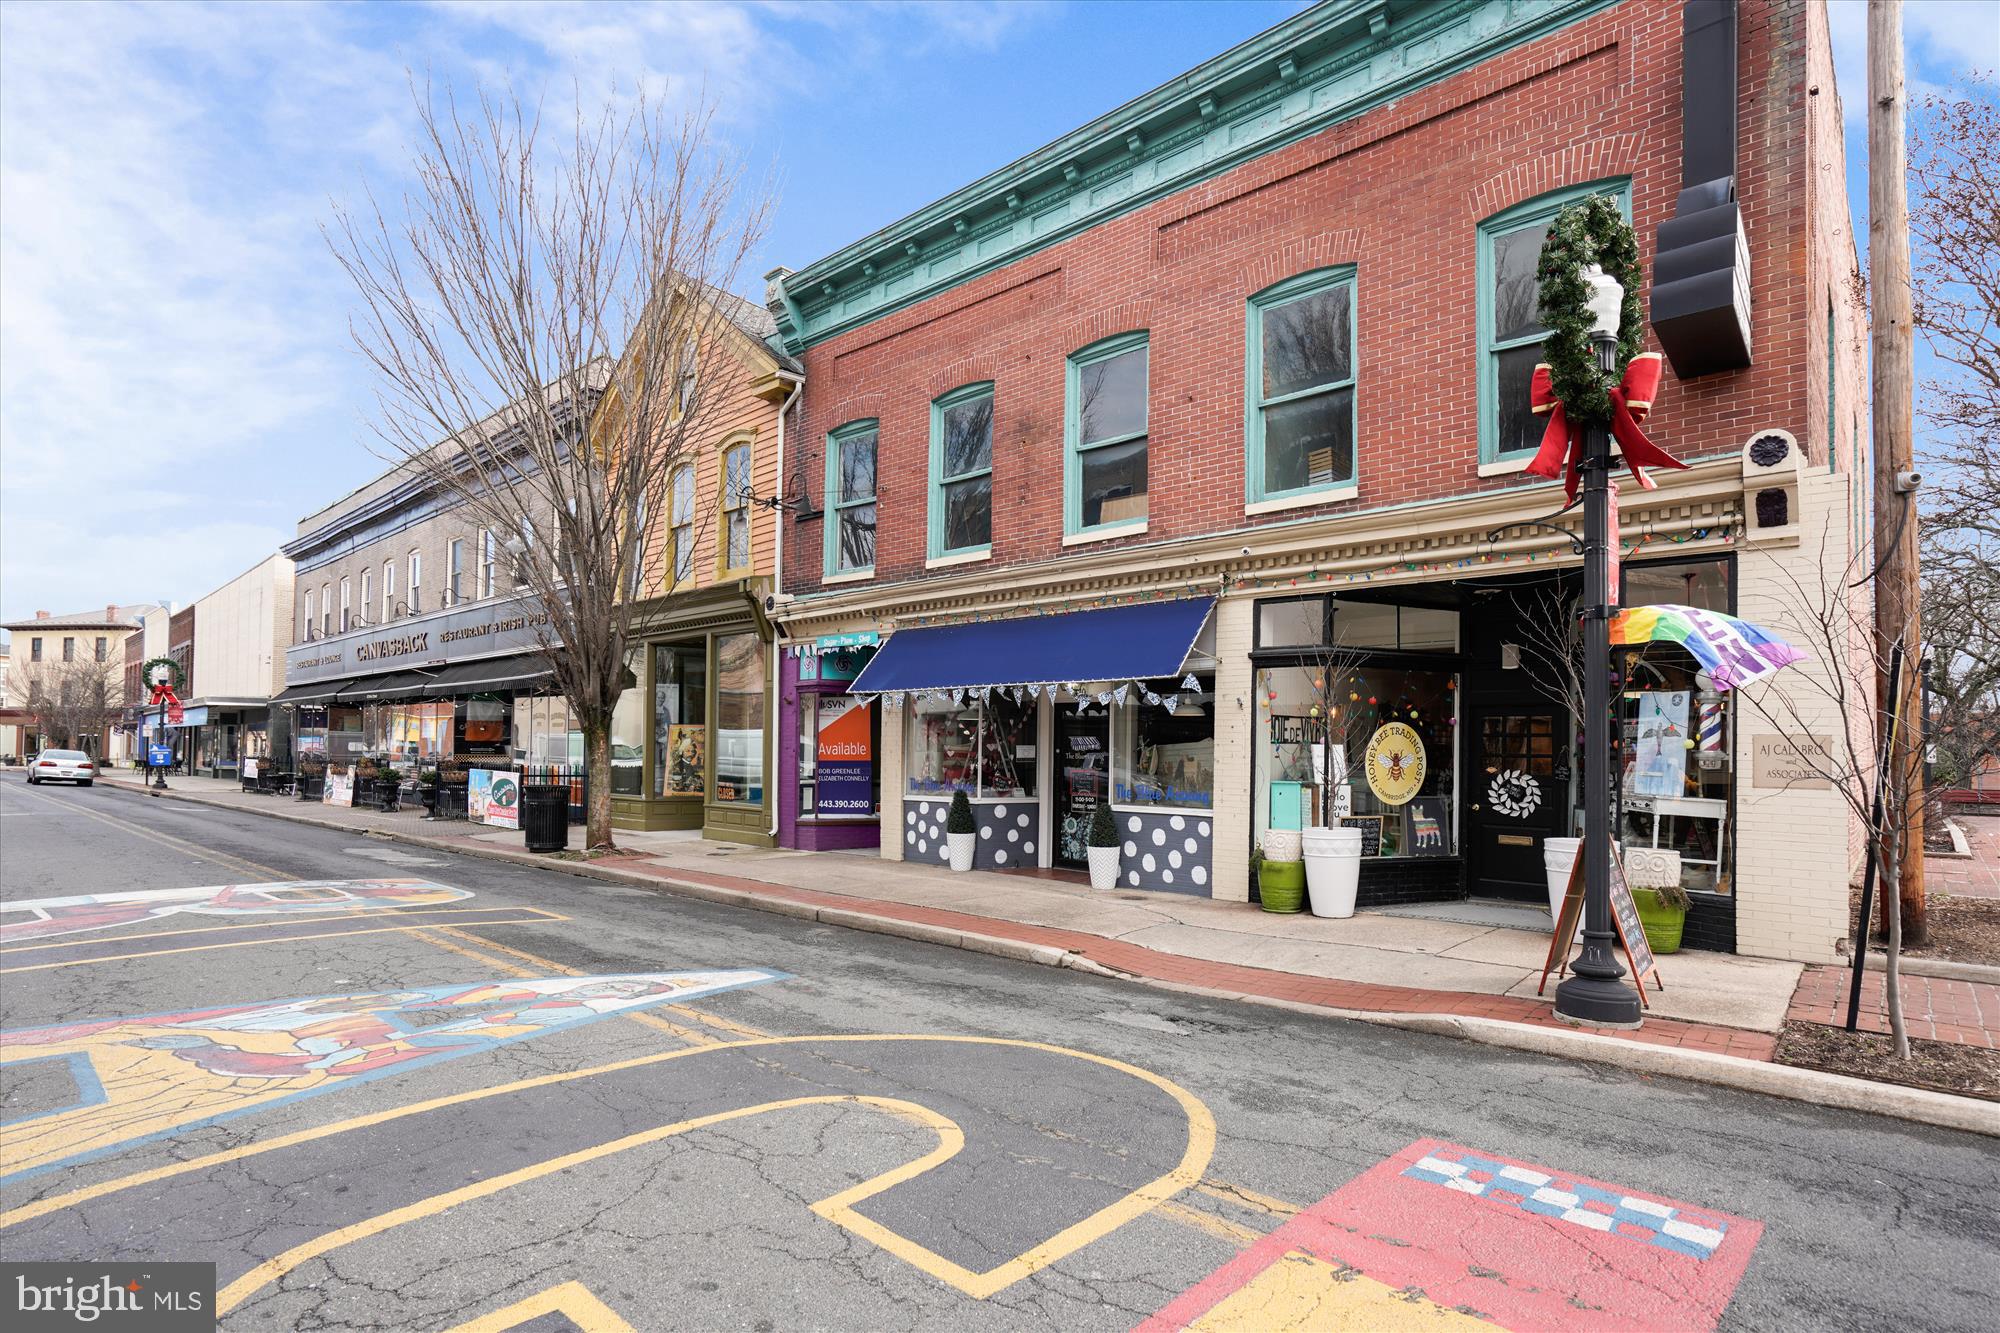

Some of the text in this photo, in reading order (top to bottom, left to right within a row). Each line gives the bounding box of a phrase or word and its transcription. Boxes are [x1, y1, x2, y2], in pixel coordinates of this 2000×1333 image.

[440, 612, 546, 643] RESTAURANT & IRISH PUB
[356, 632, 428, 661] CANVASBACK
[827, 699, 846, 709] SVN
[818, 742, 867, 755] Available
[1368, 726, 1424, 784] HONEY BEE TRADING POST
[1766, 769, 1817, 779] ASSOCIATES
[1115, 783, 1132, 800] The
[1135, 784, 1163, 800] Blue
[1406, 786, 1414, 796] MD
[818, 800, 869, 808] 443.390.2600
